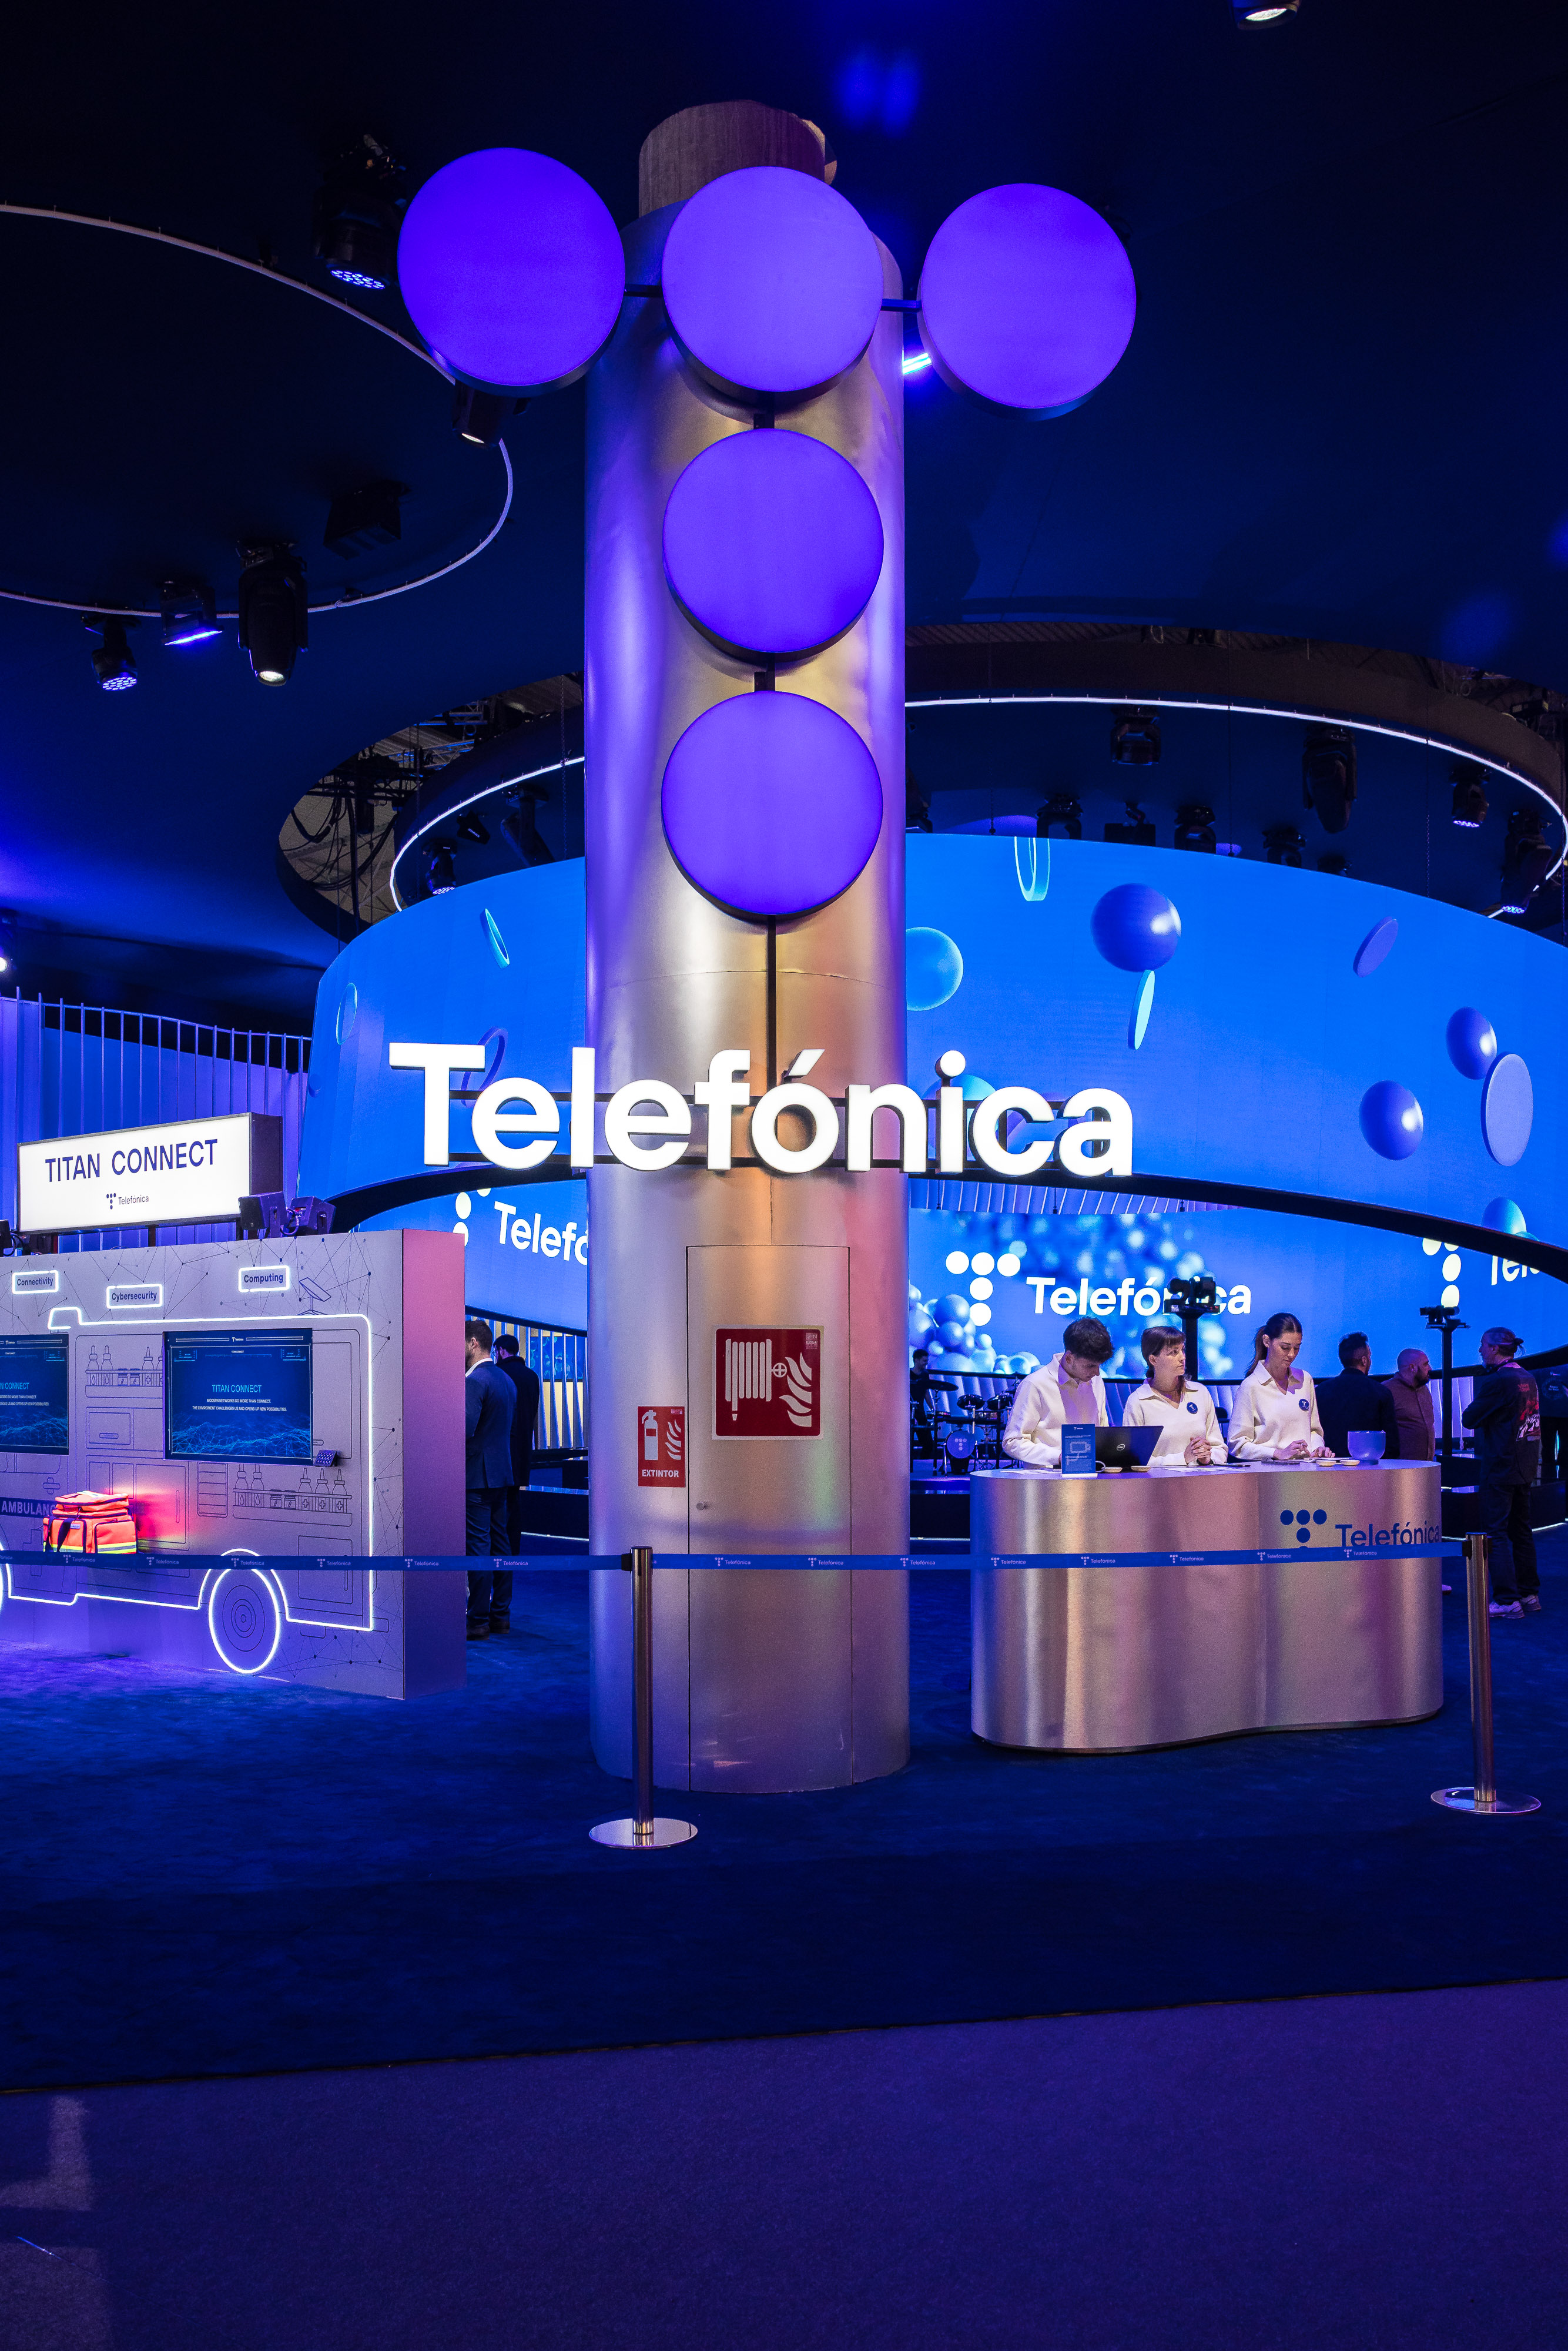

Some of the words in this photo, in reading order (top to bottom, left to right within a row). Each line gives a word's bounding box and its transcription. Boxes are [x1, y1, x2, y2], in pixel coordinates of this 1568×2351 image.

[389, 1042, 1133, 1177] Telefónica
[45, 1153, 100, 1182] TITAN
[112, 1138, 217, 1176] CONNECT
[118, 1195, 149, 1205] Telefónica
[17, 1277, 53, 1286] Connectivity
[244, 1272, 283, 1284] Computing
[112, 1291, 158, 1302] Cybersecurity
[1026, 1276, 1252, 1317] Telefóca
[212, 1384, 230, 1392] TITAN
[230, 1384, 262, 1393] CONNECT
[642, 1469, 679, 1478] EXTINTOR
